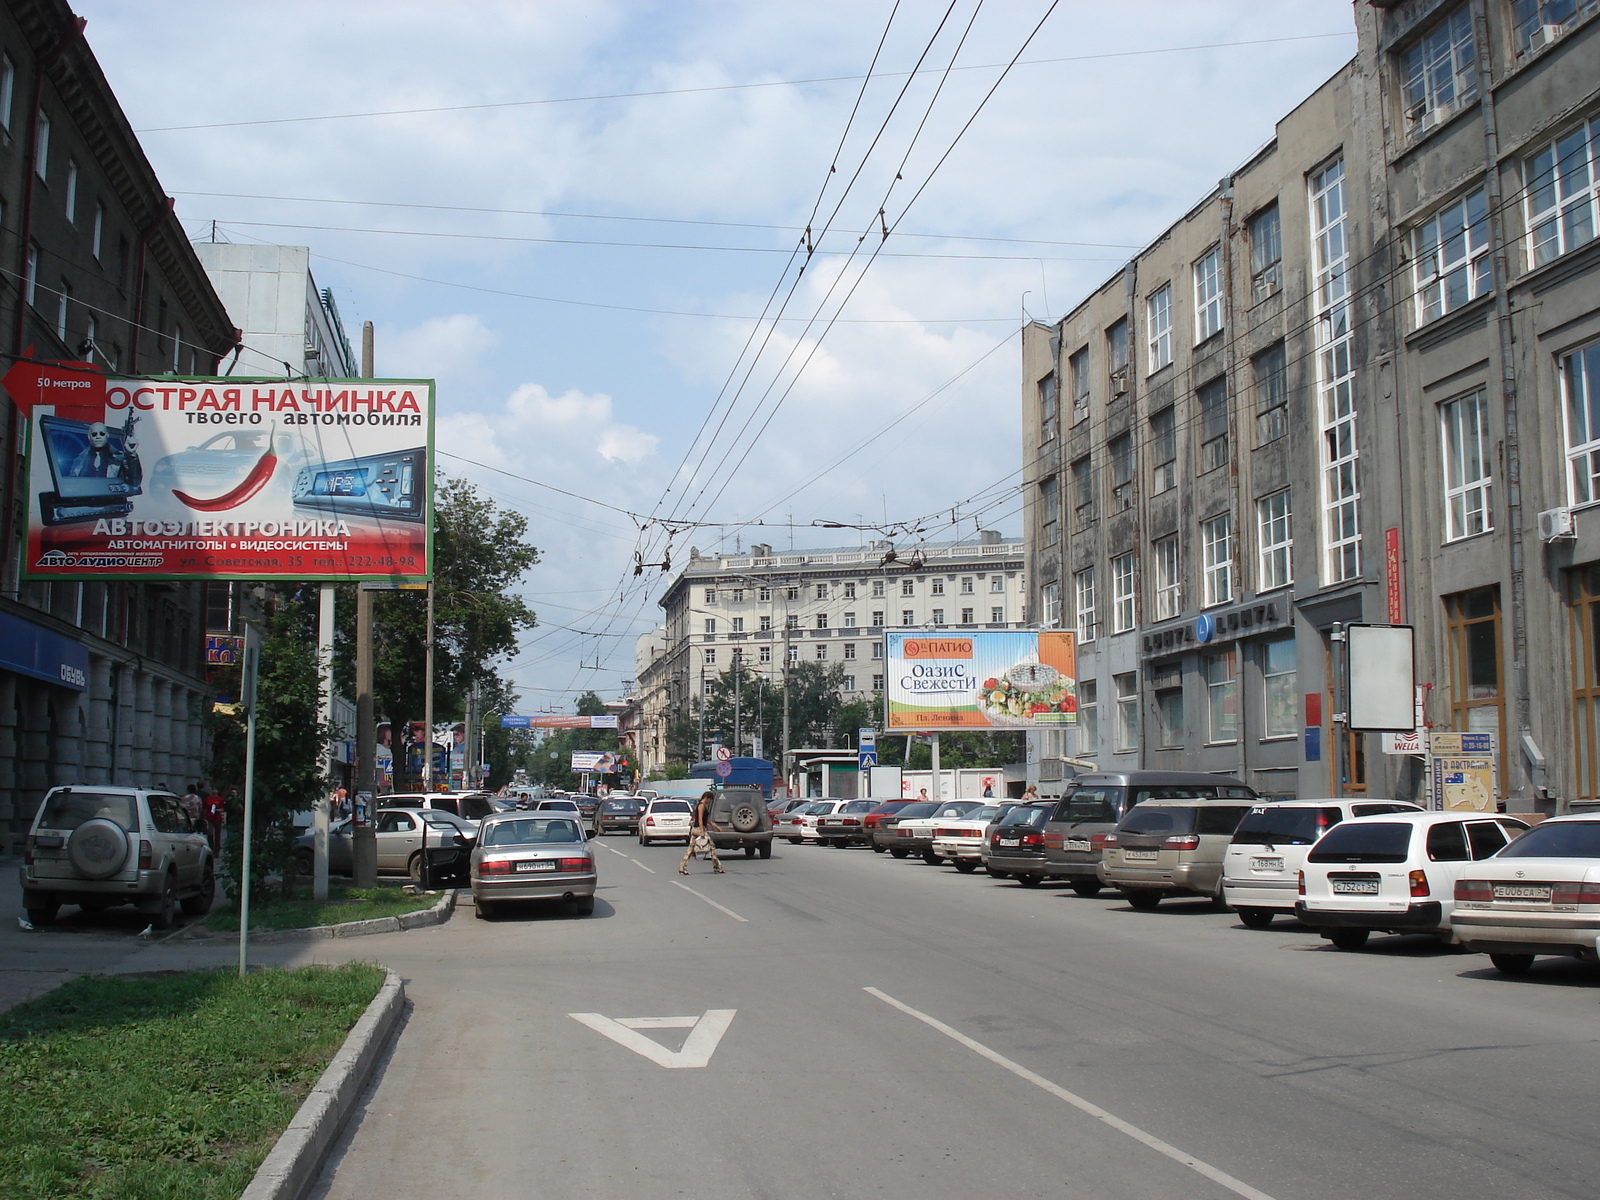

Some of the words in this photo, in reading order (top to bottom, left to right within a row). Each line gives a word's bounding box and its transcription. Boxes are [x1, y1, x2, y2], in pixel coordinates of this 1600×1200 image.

[36, 377, 51, 388] 50
[53, 379, 91, 391] метров
[105, 386, 241, 412] ОСТРАЯ
[251, 388, 421, 413] НАЧИНКА
[185, 411, 262, 425] твоего
[283, 409, 421, 426] автомобиля
[323, 475, 354, 492] MP3
[91, 517, 352, 538] АВТОЭЛЕКТРОНИКА
[107, 539, 227, 551] АВТОМАГНИТОЛЫ
[239, 540, 348, 552] ВИДЕОСИСТЕМЫ
[180, 558, 199, 569] ул.
[205, 554, 283, 568] Советская,
[287, 555, 303, 567] 35
[348, 555, 415, 567] 222-48-98
[1215, 602, 1279, 634] LUHTA
[1143, 624, 1195, 654] LUHTA
[929, 642, 972, 653] ПАТИО
[61, 663, 85, 687] ОБУВЬ
[916, 714, 930, 722] Пл.
[1394, 742, 1419, 751] WELLA
[1443, 760, 1449, 770] В
